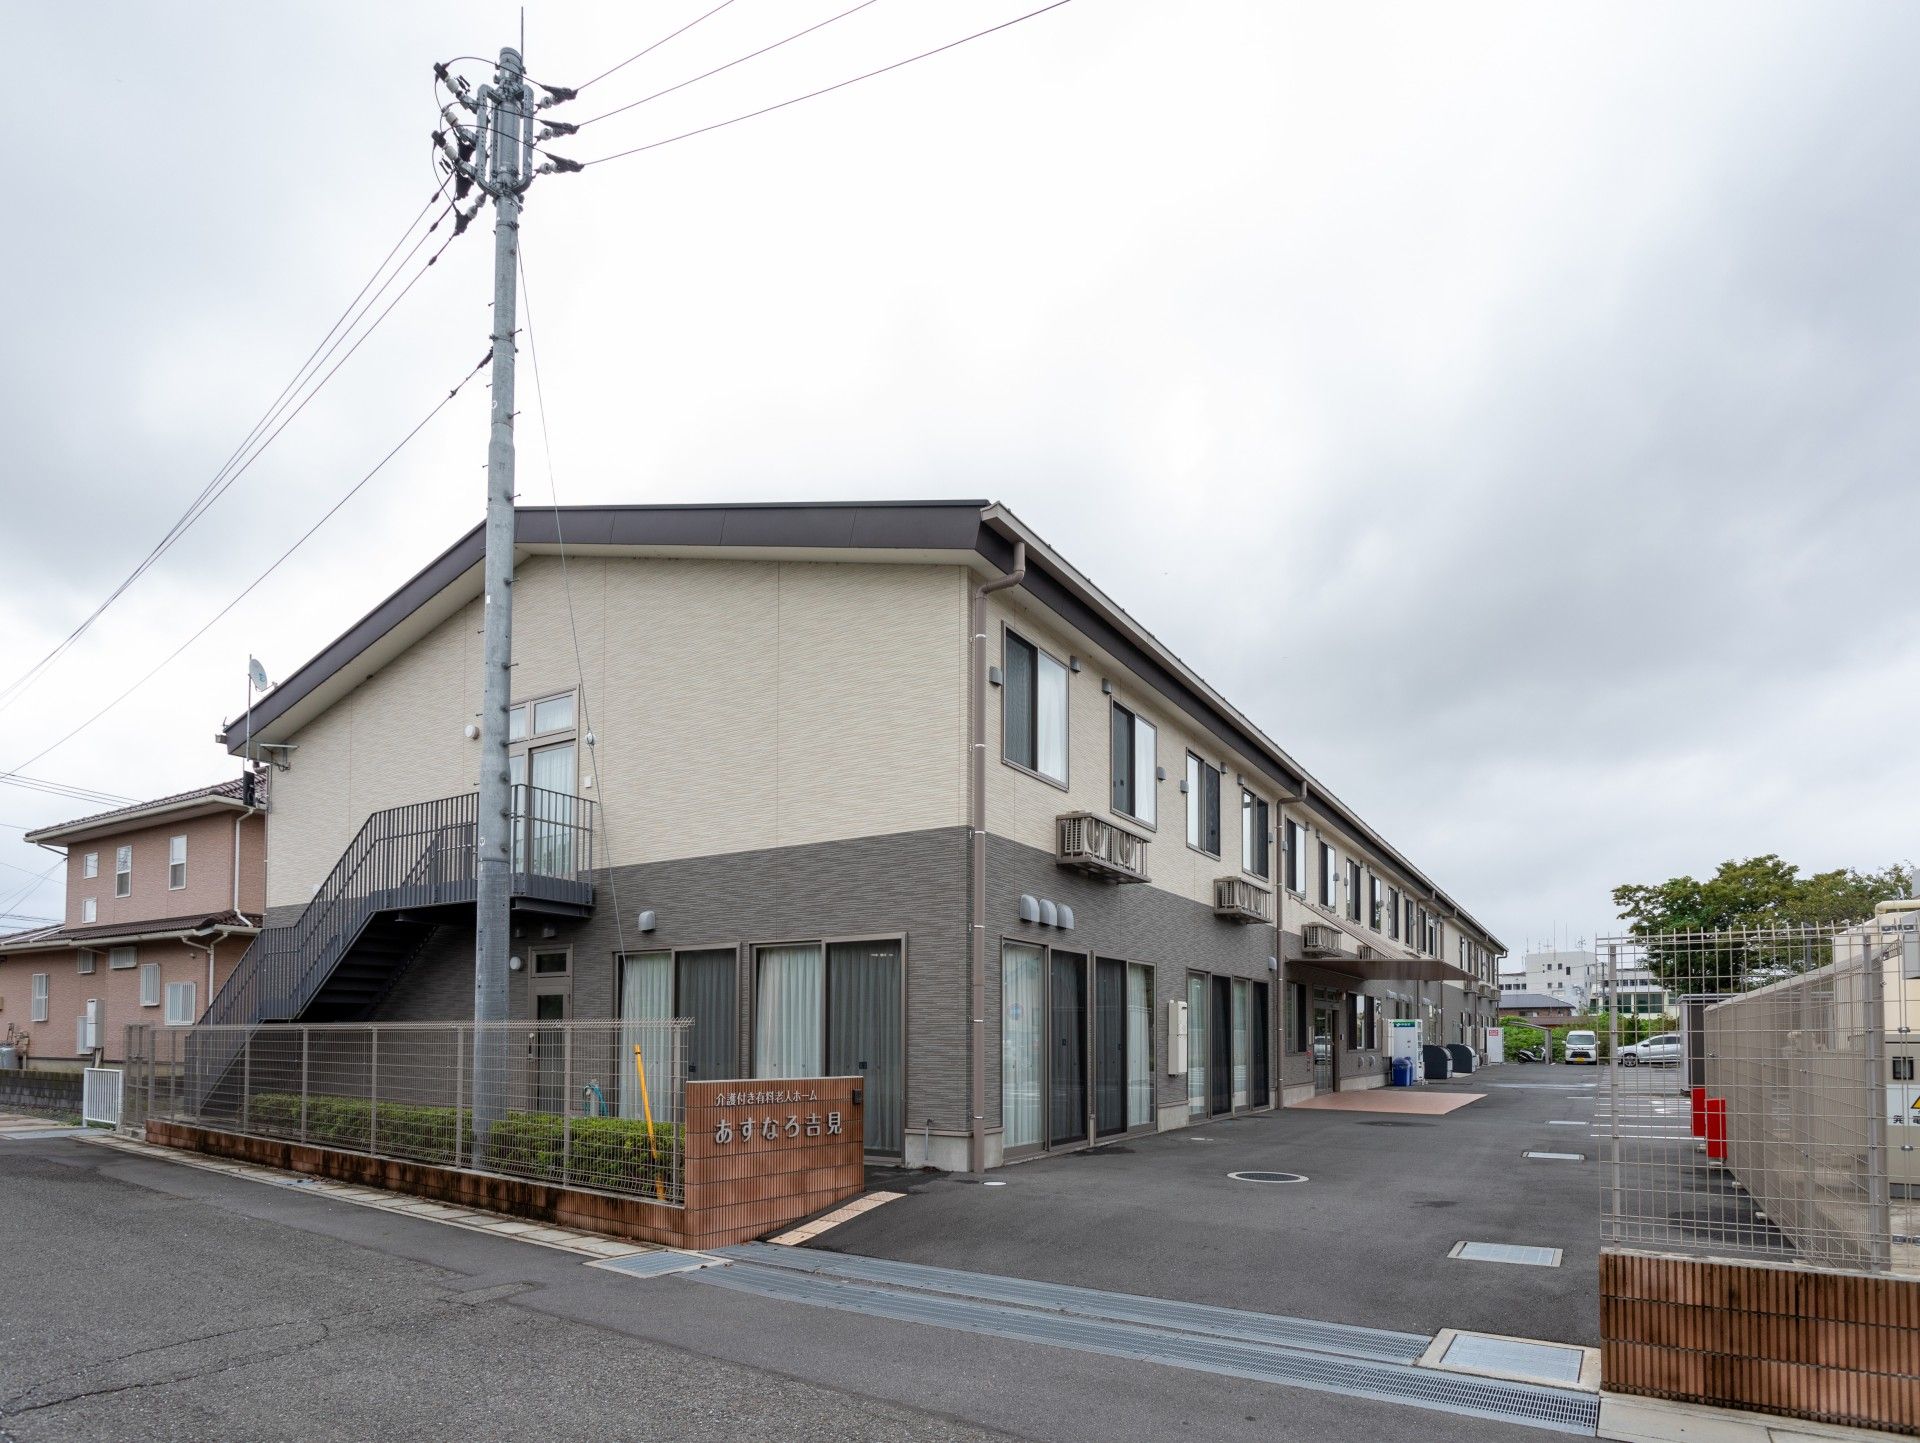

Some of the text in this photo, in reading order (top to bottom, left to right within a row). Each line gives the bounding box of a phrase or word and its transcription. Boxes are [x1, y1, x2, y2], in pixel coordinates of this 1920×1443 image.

[715, 1090, 818, 1107] 介護付き有料老人ホーム
[715, 1111, 843, 1144] あすなろ吉見
